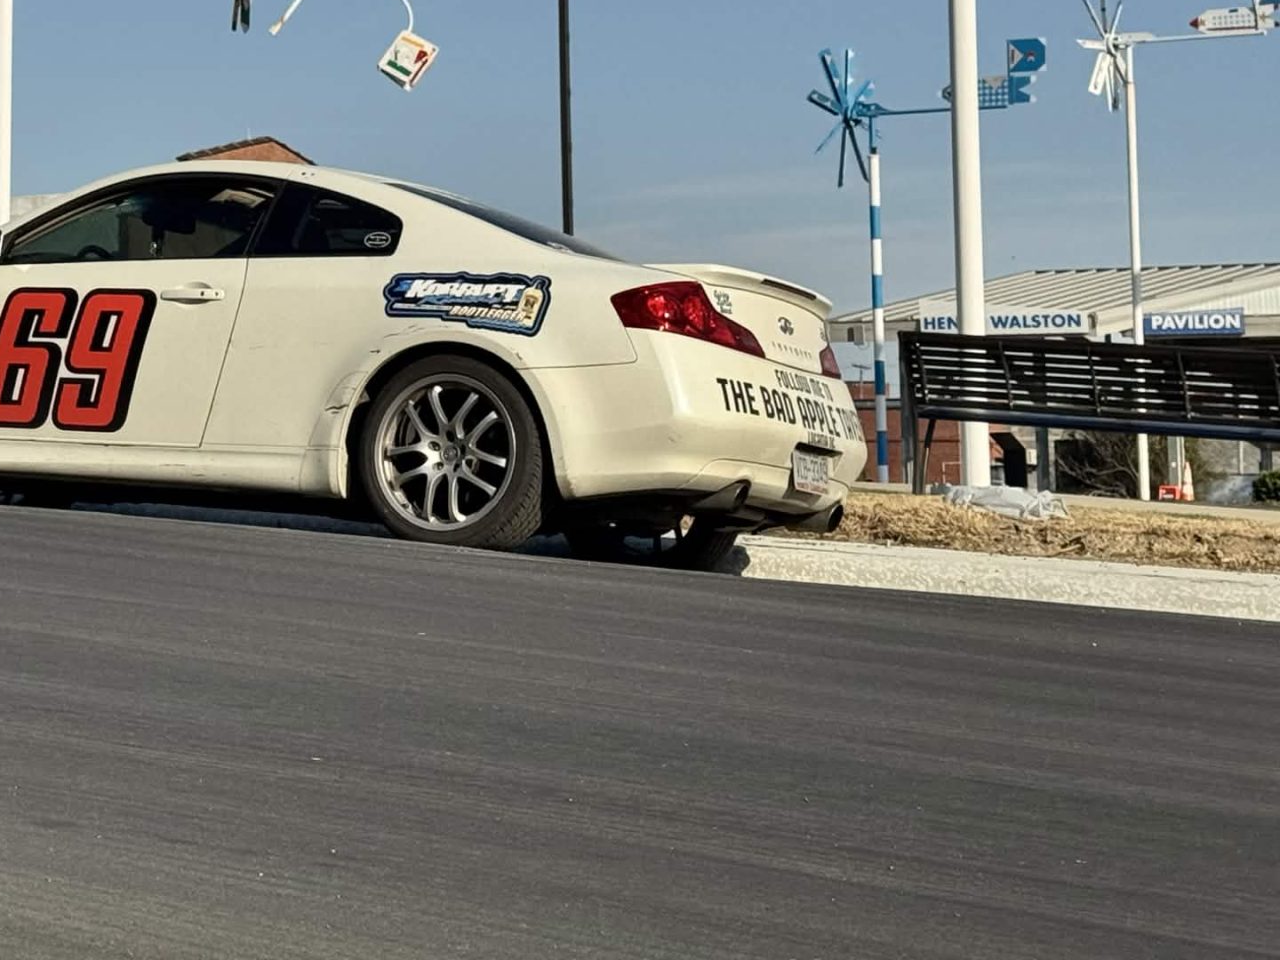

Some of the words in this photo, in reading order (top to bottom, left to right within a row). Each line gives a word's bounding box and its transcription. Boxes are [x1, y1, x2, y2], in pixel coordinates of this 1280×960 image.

[923, 315, 959, 330] HEN
[989, 313, 1082, 329] WALSTON
[1150, 312, 1241, 331] PAVILION
[716, 377, 760, 416] THE
[760, 385, 797, 425] BAD
[796, 395, 841, 438] APPLE
